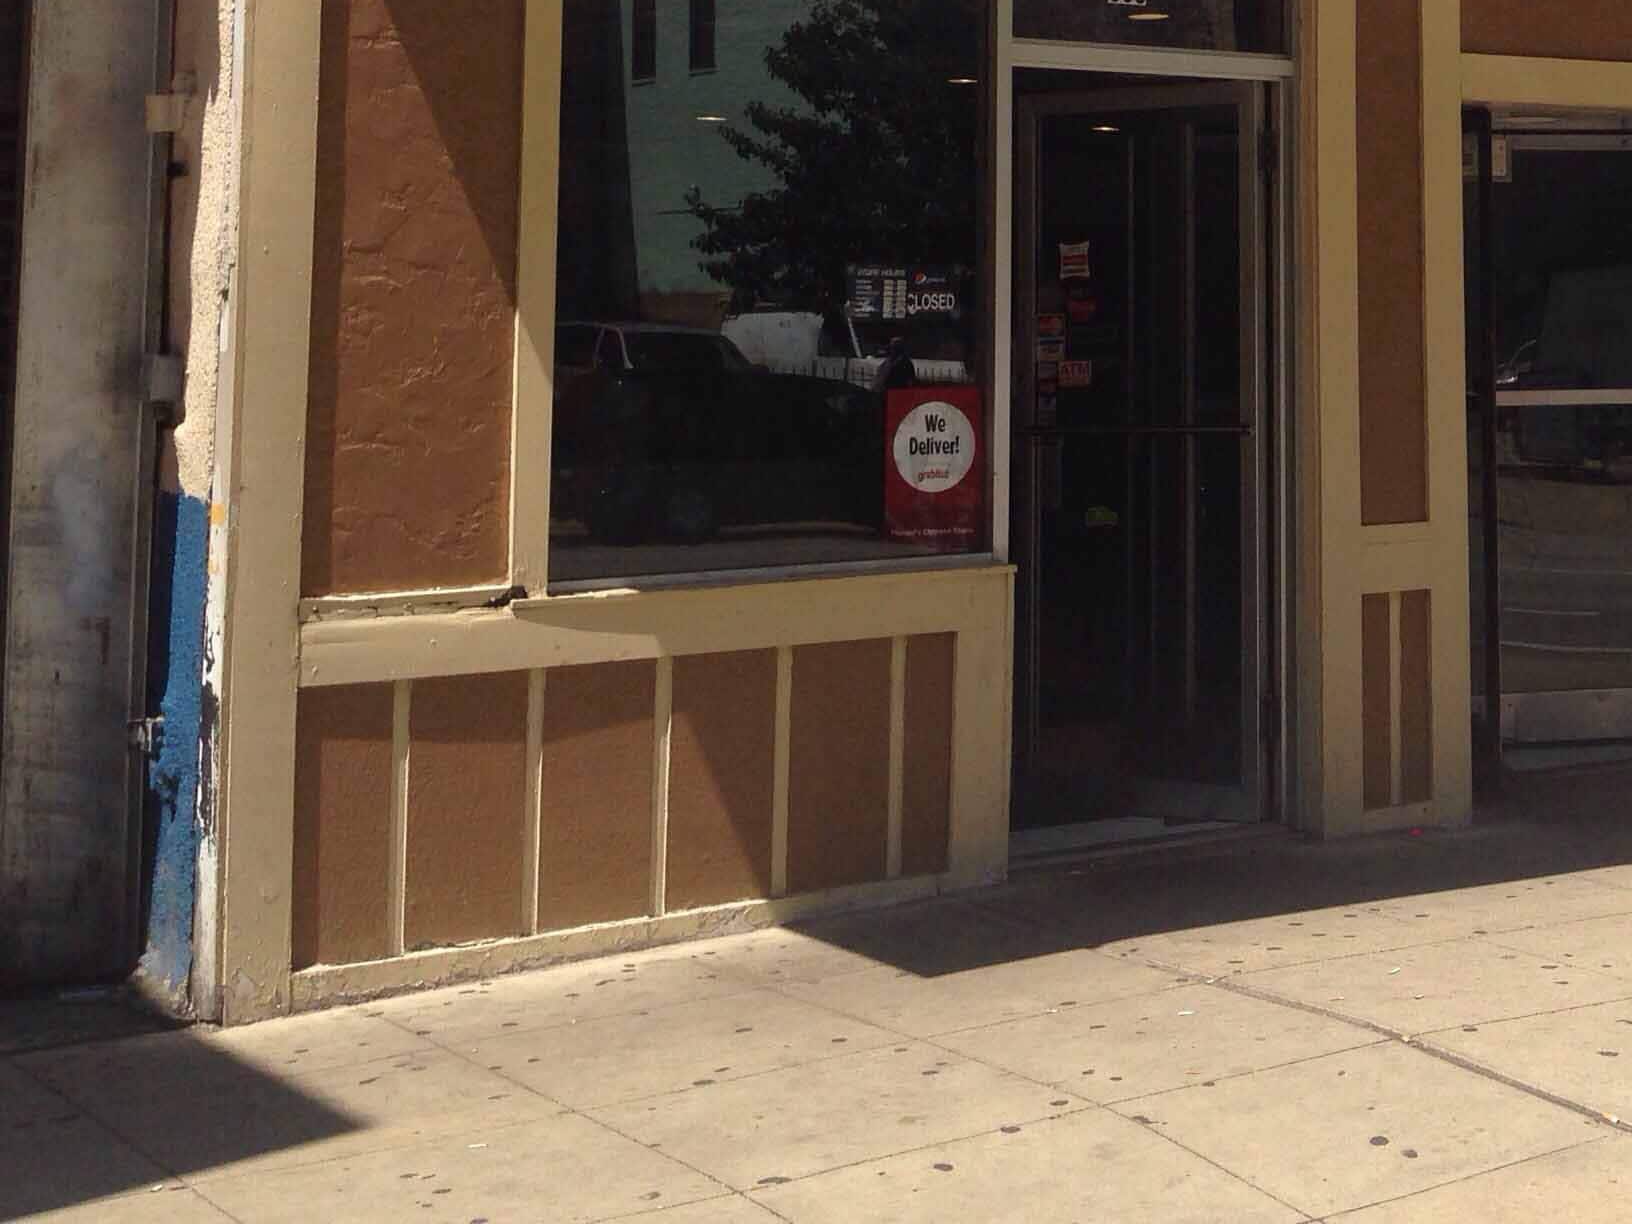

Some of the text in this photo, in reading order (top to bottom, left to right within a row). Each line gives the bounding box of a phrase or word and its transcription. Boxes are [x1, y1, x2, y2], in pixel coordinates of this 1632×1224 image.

[907, 292, 956, 311] CLOSED
[924, 413, 946, 433] We
[909, 435, 960, 456] Deliver!
